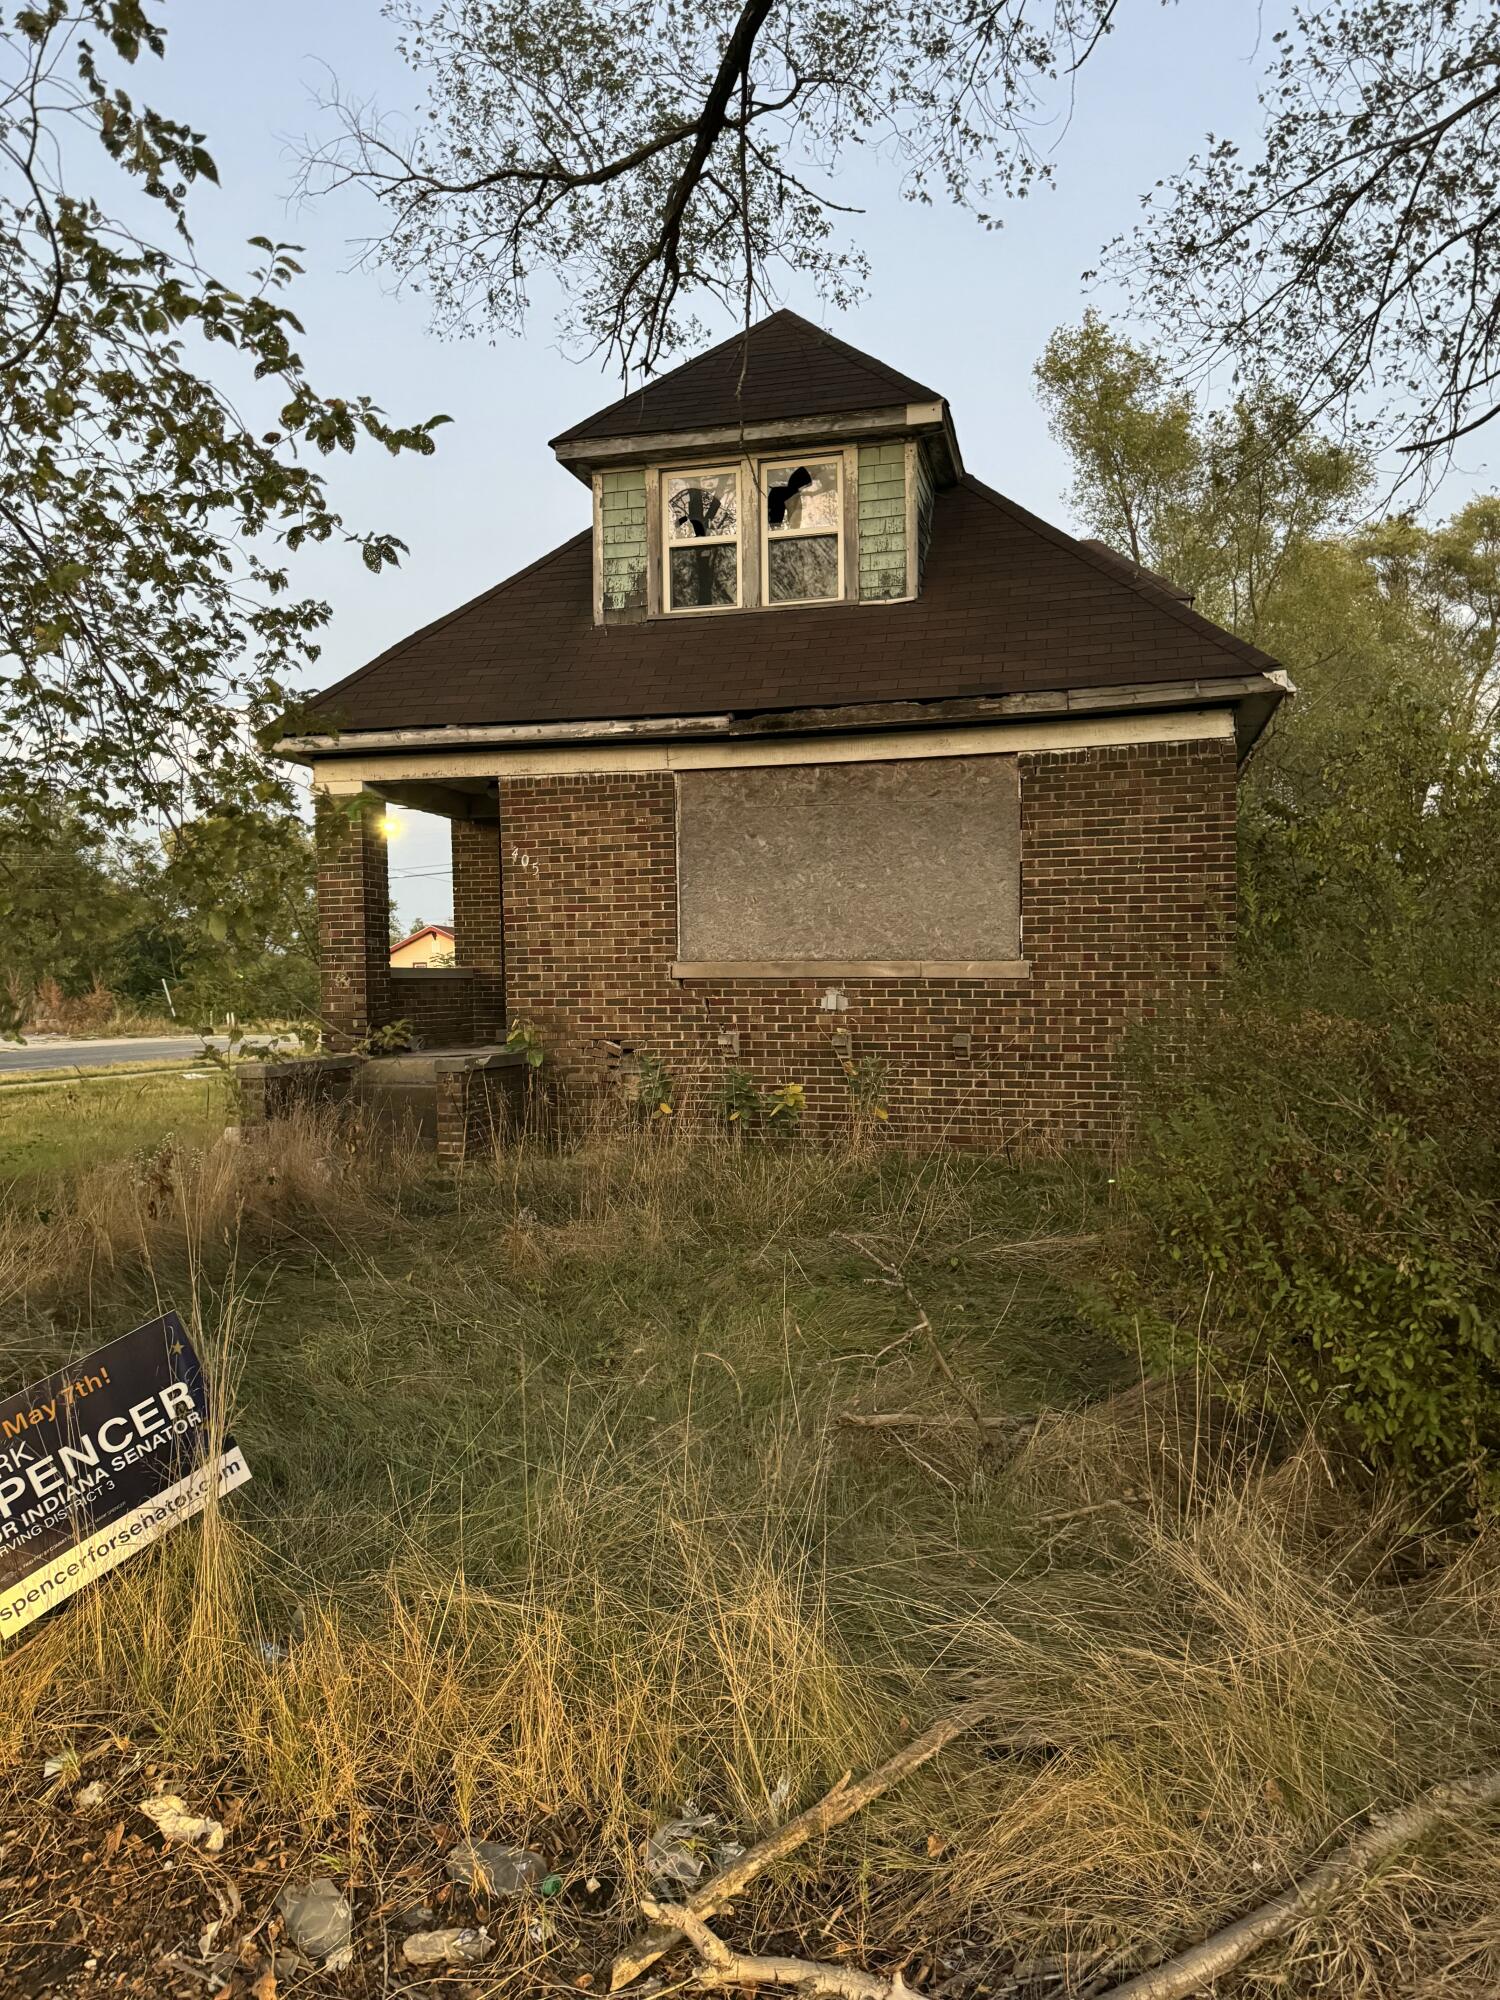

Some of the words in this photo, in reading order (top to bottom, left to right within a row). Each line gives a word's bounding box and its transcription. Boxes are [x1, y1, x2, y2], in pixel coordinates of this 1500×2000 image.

[512, 847, 539, 876] 405
[1, 1399, 56, 1438] May
[61, 1366, 111, 1404] 7th!
[21, 1468, 110, 1527] INDIANA
[111, 1412, 201, 1471] SENATOR
[44, 1485, 102, 1528] DISTRICT
[106, 1480, 116, 1490] 3
